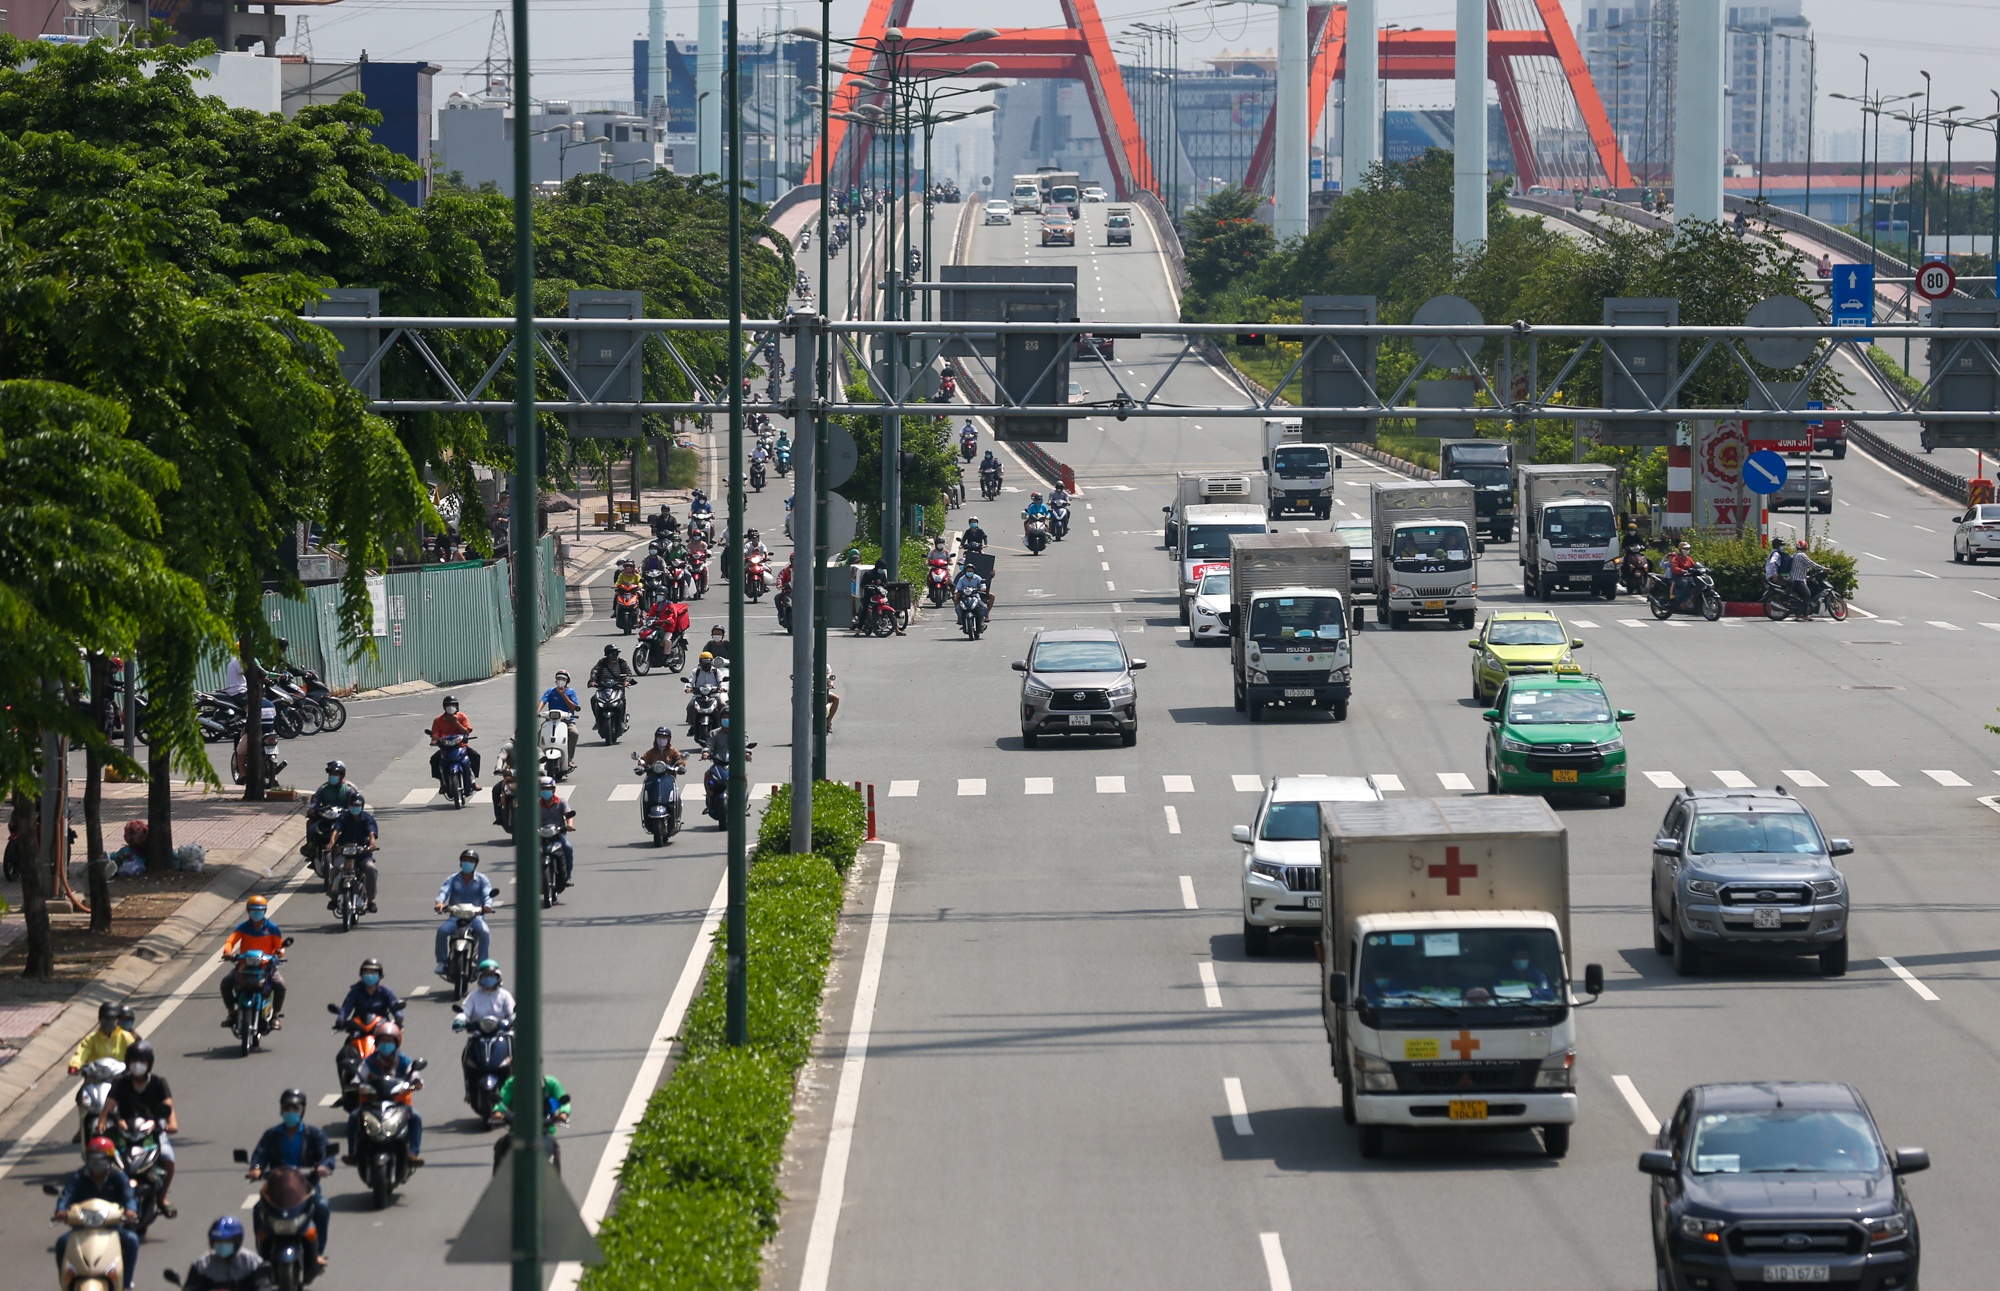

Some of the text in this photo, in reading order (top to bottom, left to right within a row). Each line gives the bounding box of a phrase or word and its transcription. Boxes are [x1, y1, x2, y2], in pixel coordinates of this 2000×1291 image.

[1927, 273, 1943, 289] 80
[1714, 505, 1752, 524] XV
[1760, 910, 1774, 918] 29C
[1460, 1102, 1477, 1110] 51C
[1455, 1110, 1483, 1119] 104.81
